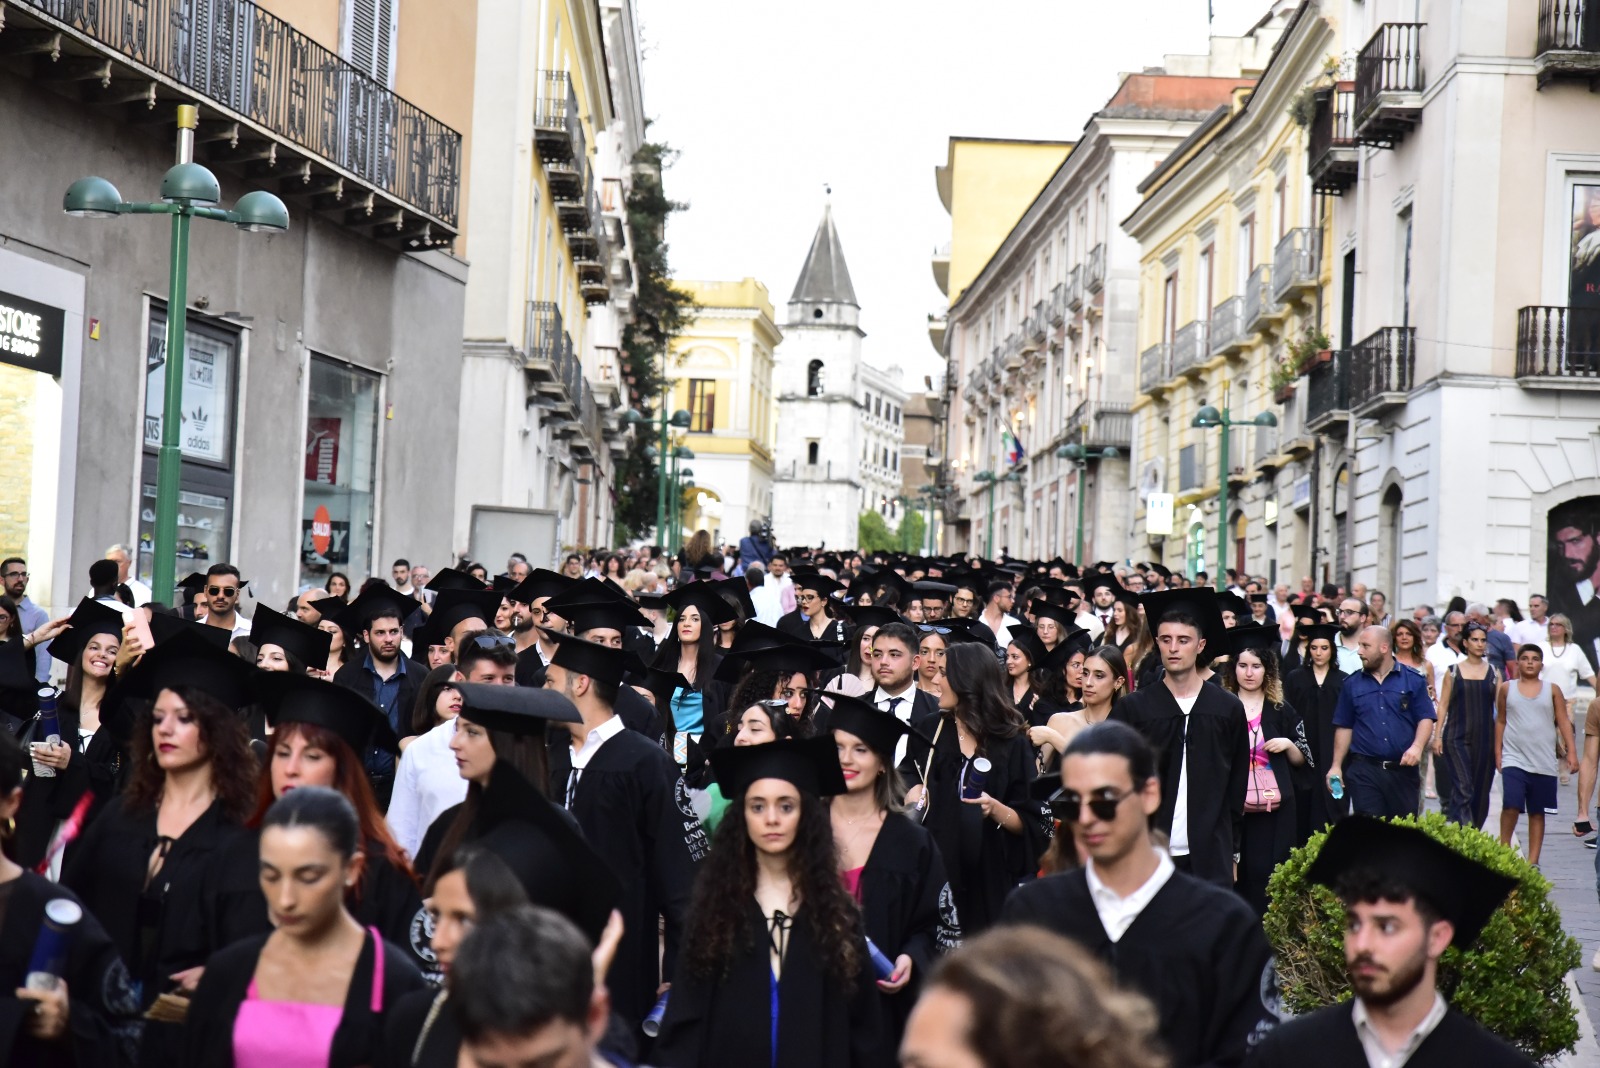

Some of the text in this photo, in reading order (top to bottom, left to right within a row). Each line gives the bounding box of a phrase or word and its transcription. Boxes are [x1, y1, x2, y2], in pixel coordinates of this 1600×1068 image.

[1586, 283, 1600, 293] R
[0, 304, 41, 341] STORE
[145, 420, 160, 441] NS
[187, 435, 210, 451] adidas
[317, 438, 334, 484] PUMA
